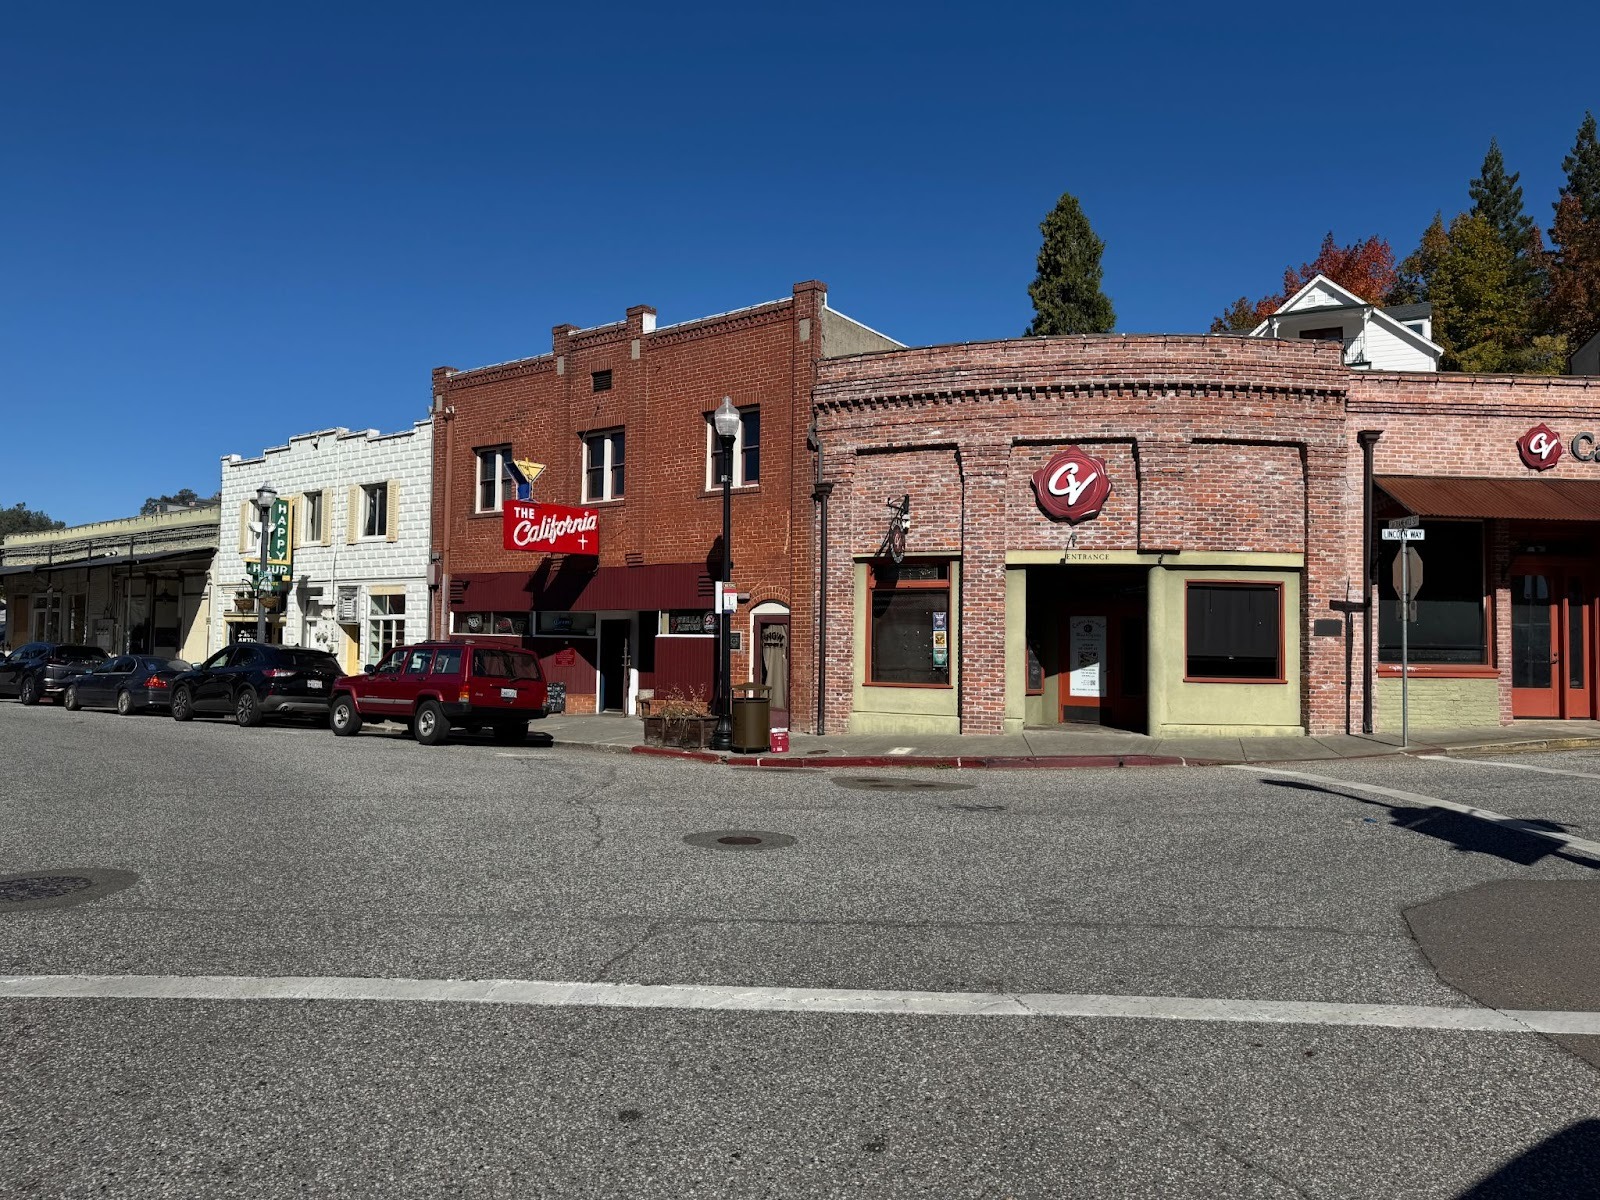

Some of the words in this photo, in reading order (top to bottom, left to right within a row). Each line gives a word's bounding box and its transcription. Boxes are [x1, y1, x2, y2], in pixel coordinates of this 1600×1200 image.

[513, 506, 535, 520] THE
[277, 503, 288, 561] HAPPY
[513, 511, 598, 546] California
[1410, 530, 1423, 539] WAY
[1066, 553, 1110, 561] ENTRANCE
